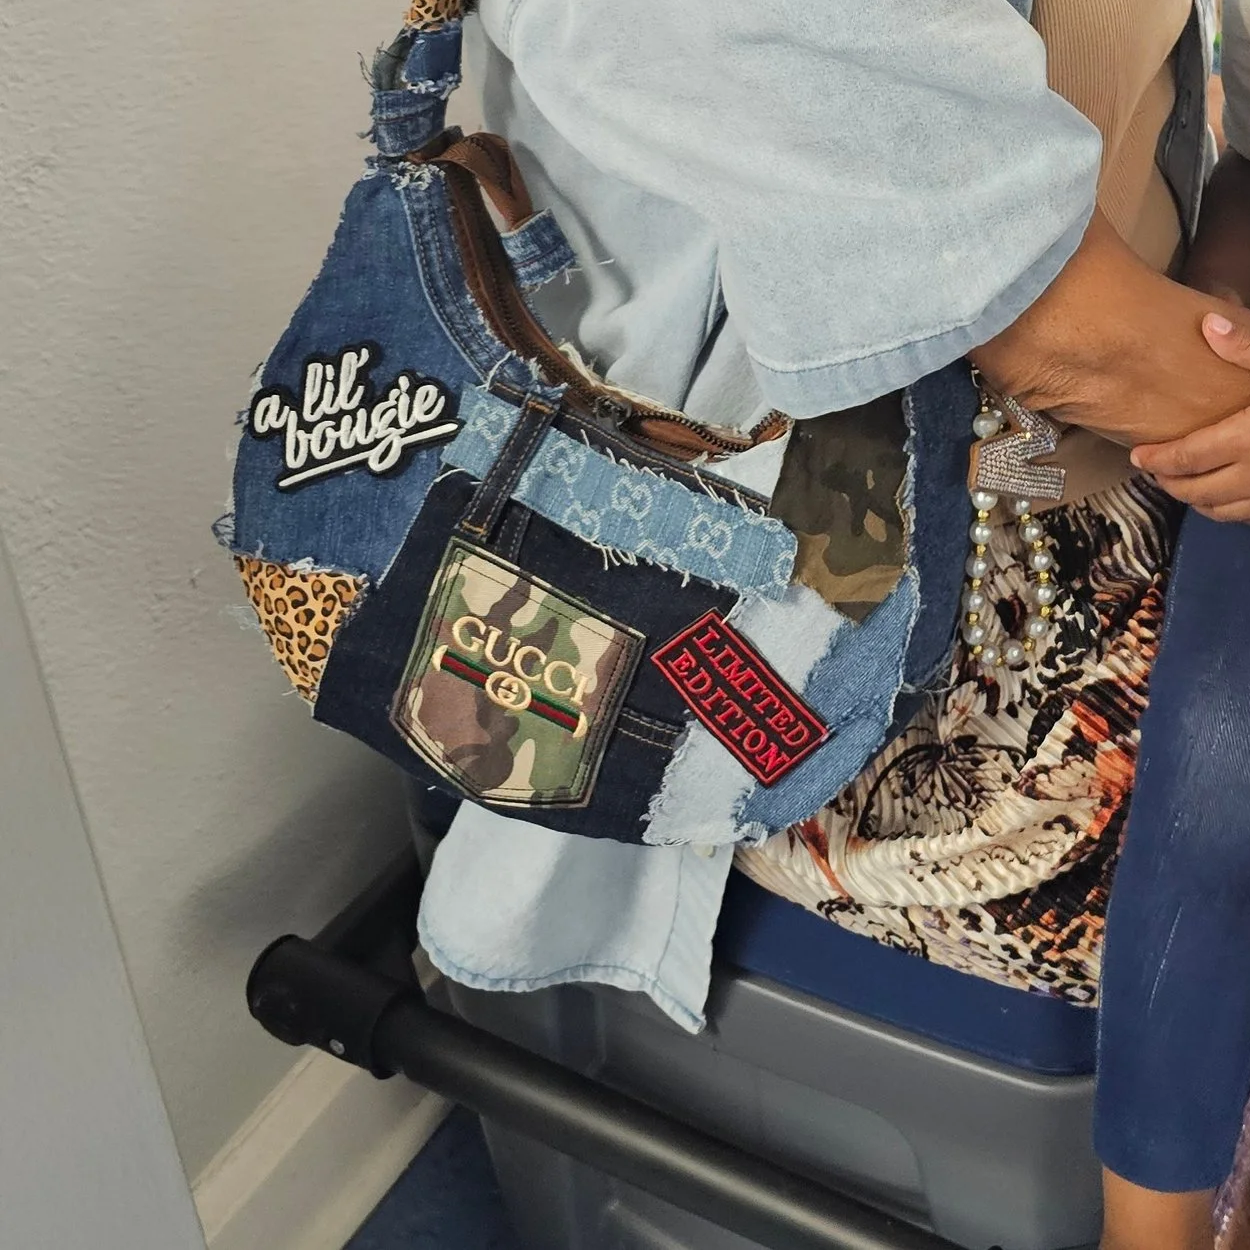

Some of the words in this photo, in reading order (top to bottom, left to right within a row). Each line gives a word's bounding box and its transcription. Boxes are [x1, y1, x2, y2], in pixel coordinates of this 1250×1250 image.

[254, 394, 290, 434] a
[285, 375, 446, 472] bougie
[452, 616, 589, 706] GUCCI
[693, 626, 810, 748] LIMITED
[667, 648, 791, 772] EDITION
